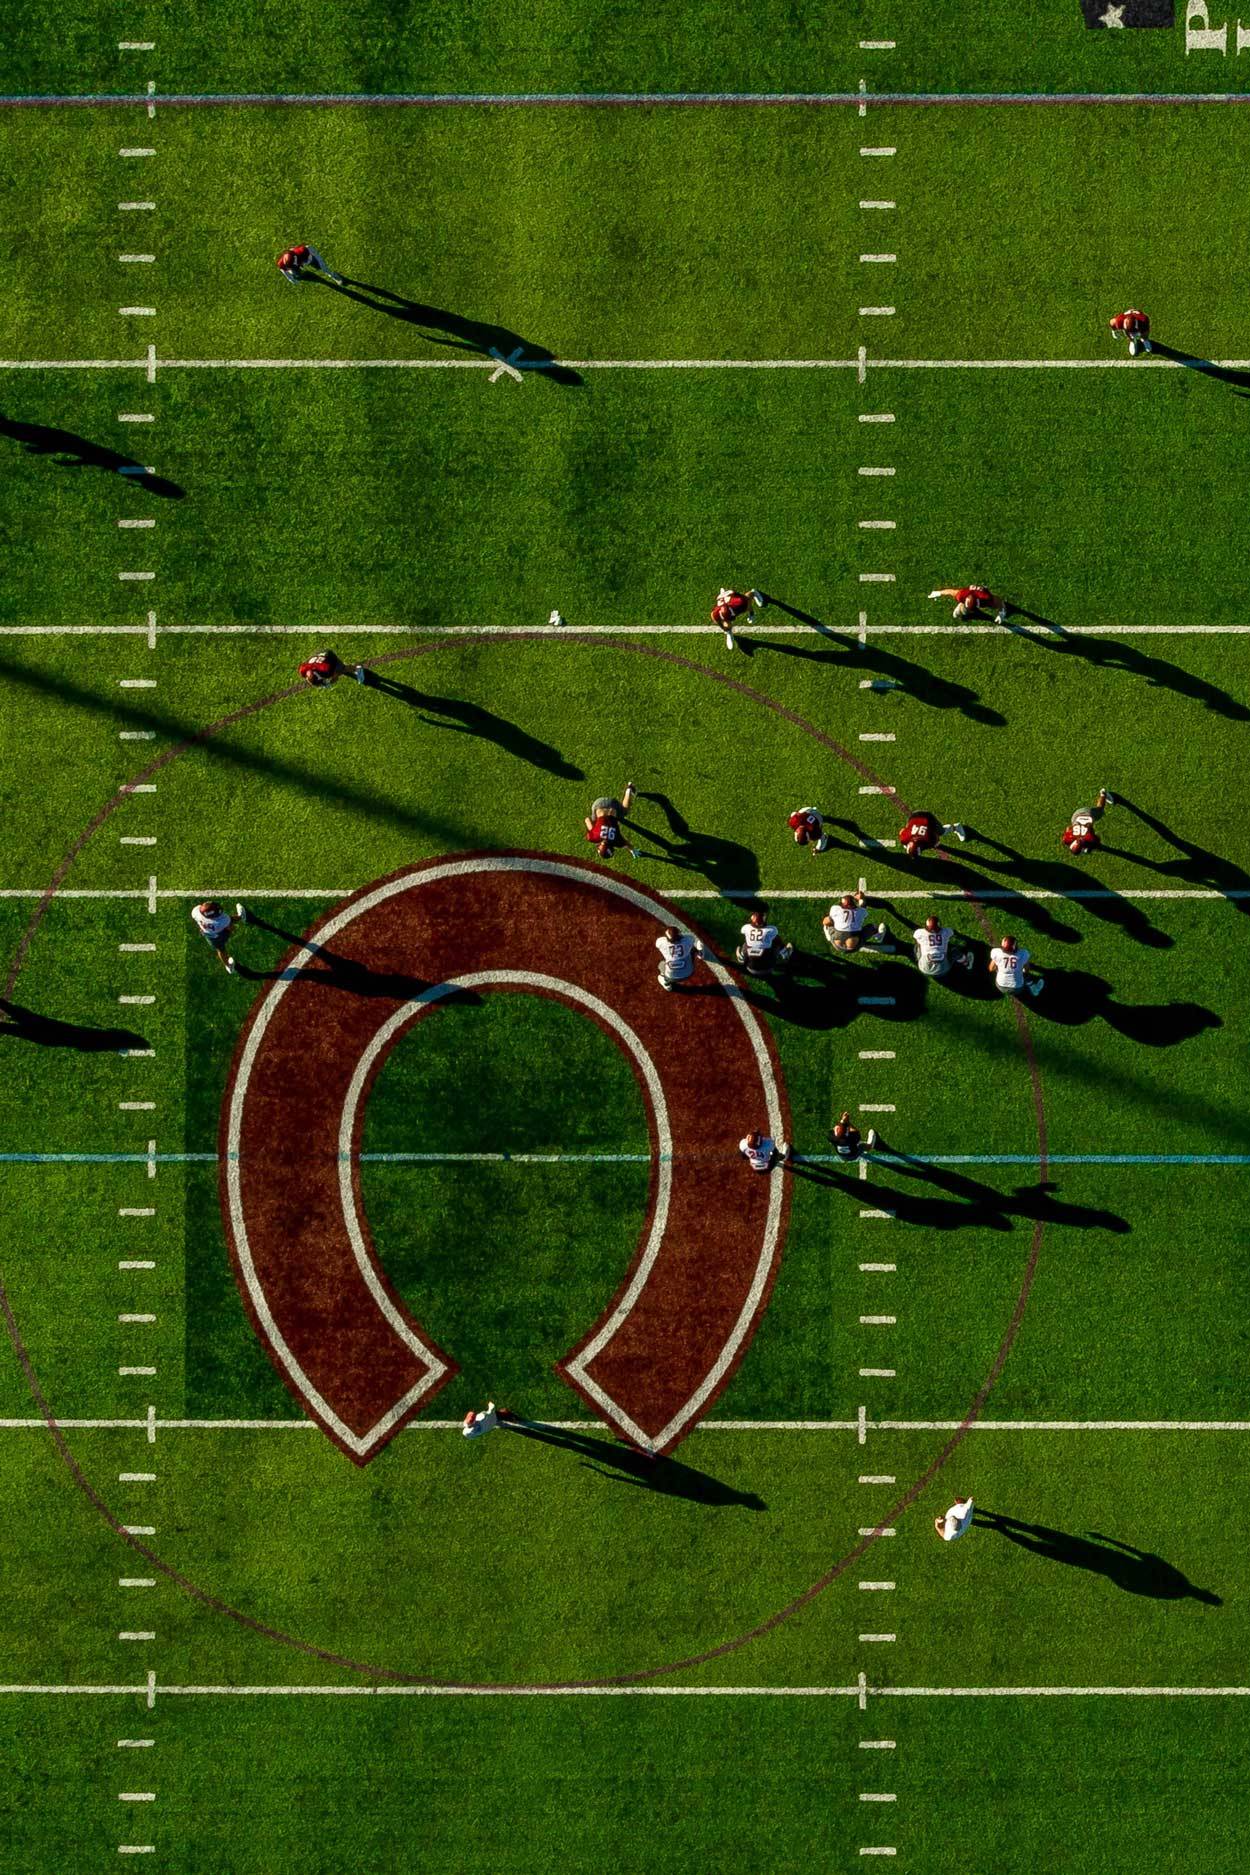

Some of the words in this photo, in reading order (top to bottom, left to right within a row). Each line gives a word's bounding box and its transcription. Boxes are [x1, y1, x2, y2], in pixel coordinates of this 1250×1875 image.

[749, 928, 762, 941] 62
[668, 944, 684, 957] 73
[1002, 956, 1017, 969] 76
